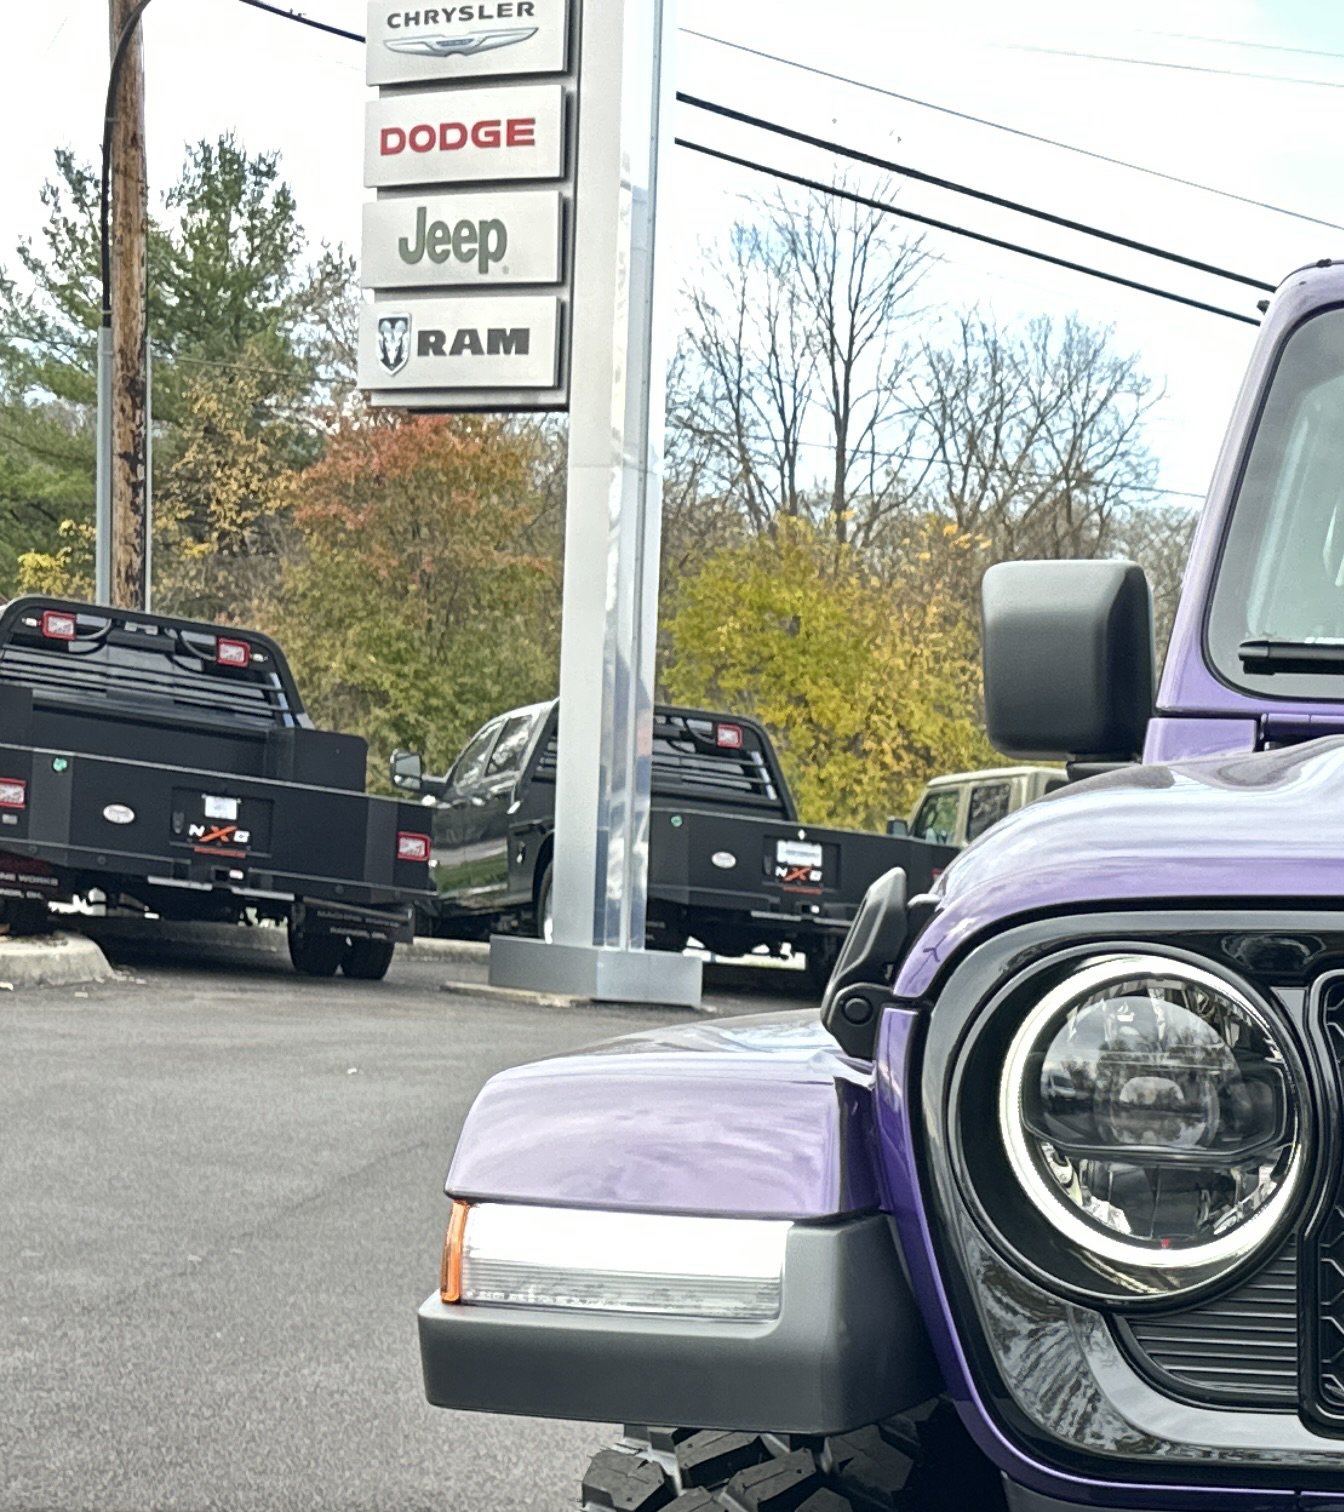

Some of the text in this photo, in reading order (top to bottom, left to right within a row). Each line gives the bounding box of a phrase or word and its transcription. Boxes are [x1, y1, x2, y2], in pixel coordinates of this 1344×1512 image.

[386, 1, 535, 29] CHRYSLER
[380, 117, 536, 156] DODGE
[398, 206, 508, 275] Jeep
[416, 327, 531, 358] RAM
